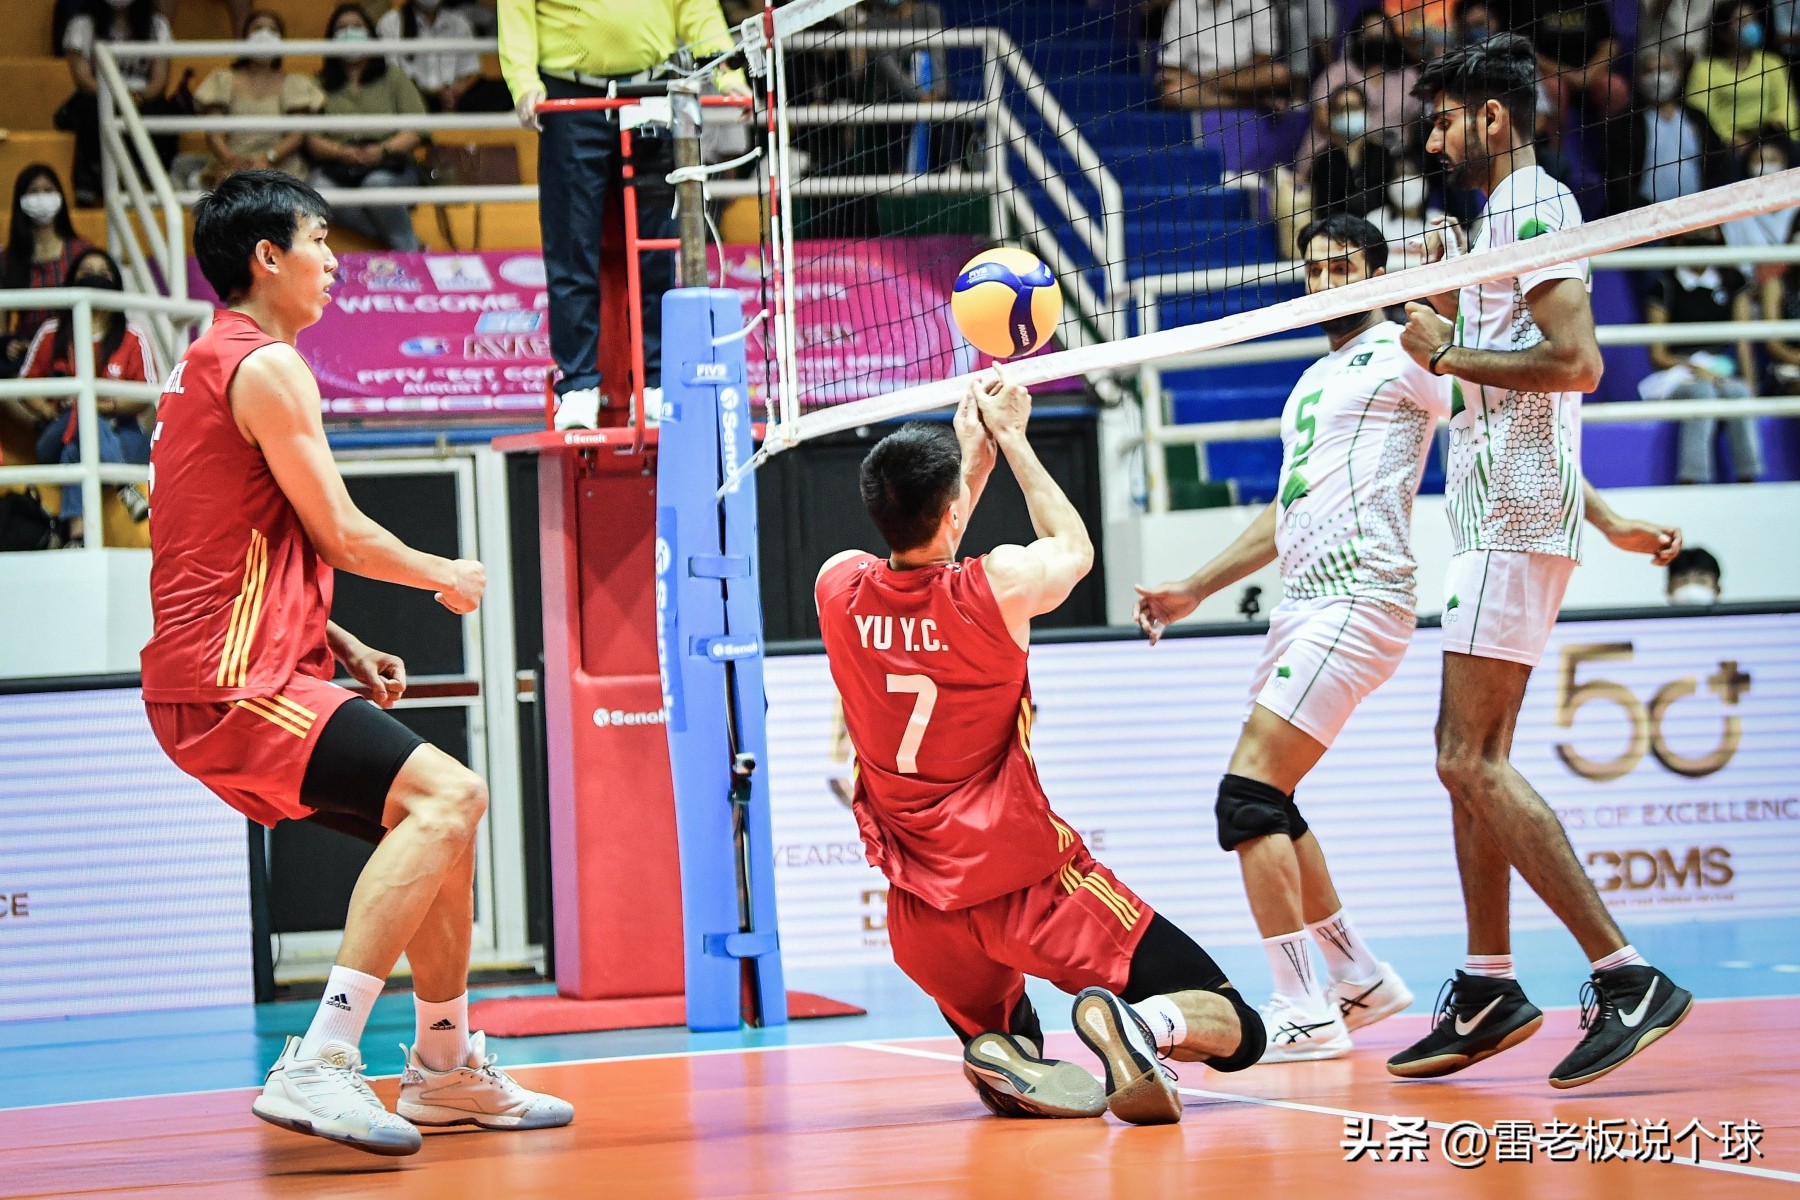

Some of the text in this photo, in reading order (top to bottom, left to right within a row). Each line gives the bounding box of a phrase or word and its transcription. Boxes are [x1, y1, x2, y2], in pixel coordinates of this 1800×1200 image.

[336, 293, 520, 313] WELCOME
[1292, 388, 1323, 458] 5
[854, 615, 949, 651] YU Y.C.
[886, 673, 938, 774] 7
[1594, 806, 1630, 826] OF
